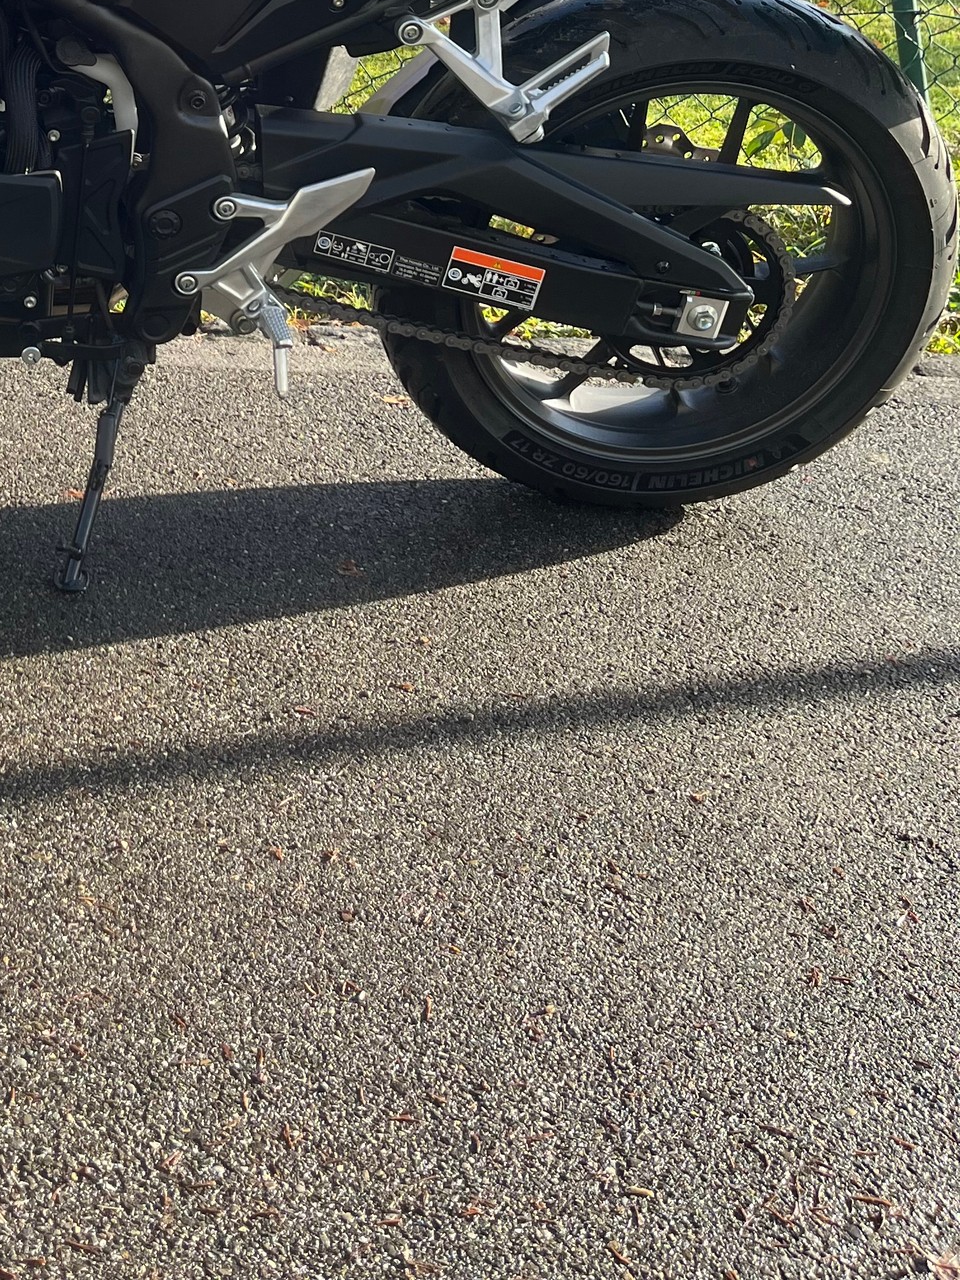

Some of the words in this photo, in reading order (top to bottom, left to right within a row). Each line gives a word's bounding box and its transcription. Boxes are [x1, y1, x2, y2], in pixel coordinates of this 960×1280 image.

[532, 449, 560, 468] ZR
[648, 454, 765, 489] MICHELIN
[562, 462, 629, 488] 160/60
